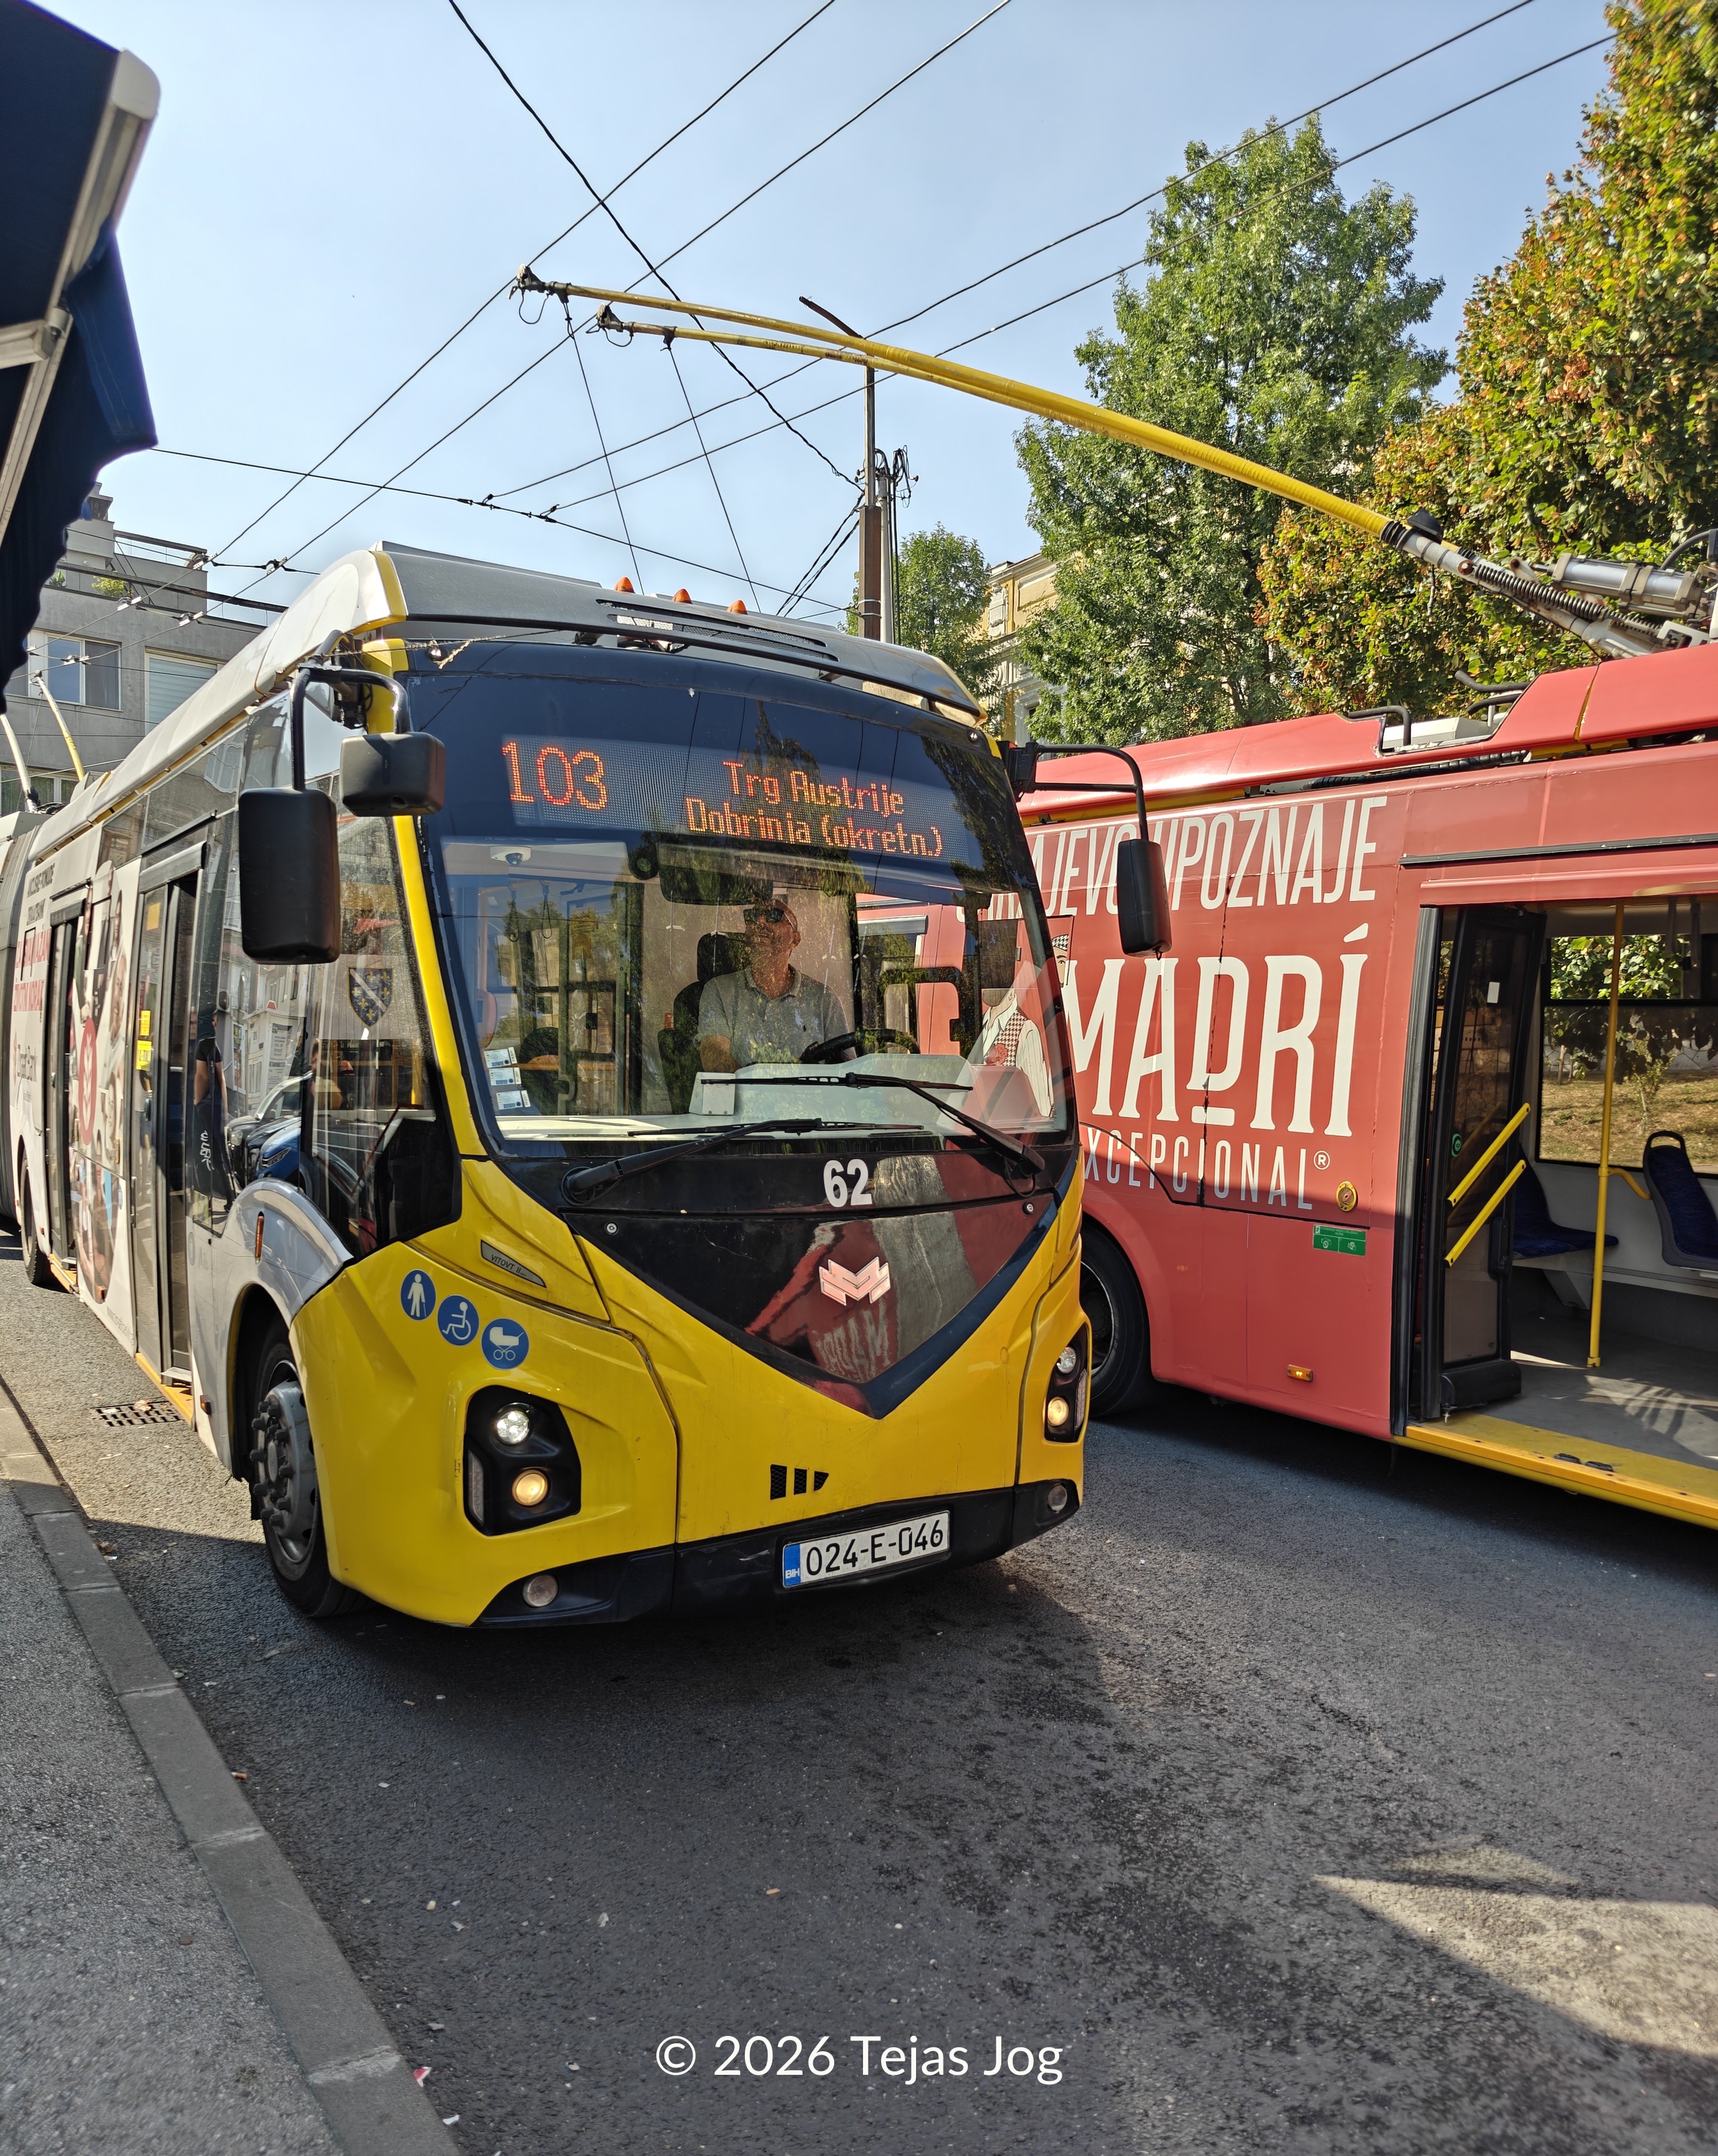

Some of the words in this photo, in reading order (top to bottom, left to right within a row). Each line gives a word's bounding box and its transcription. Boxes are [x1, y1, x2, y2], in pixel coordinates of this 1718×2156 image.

[502, 741, 607, 810] 103
[723, 760, 782, 805] Trg
[789, 770, 905, 817] Austrije
[1061, 922, 1368, 1137] MADRÍ
[823, 1159, 873, 1208] 62
[1084, 1126, 1330, 1210] XCEPCIONAL®
[492, 1254, 515, 1270] VITOVT
[785, 1568, 800, 1579] BIH
[806, 1519, 944, 1576] 024-E-046
